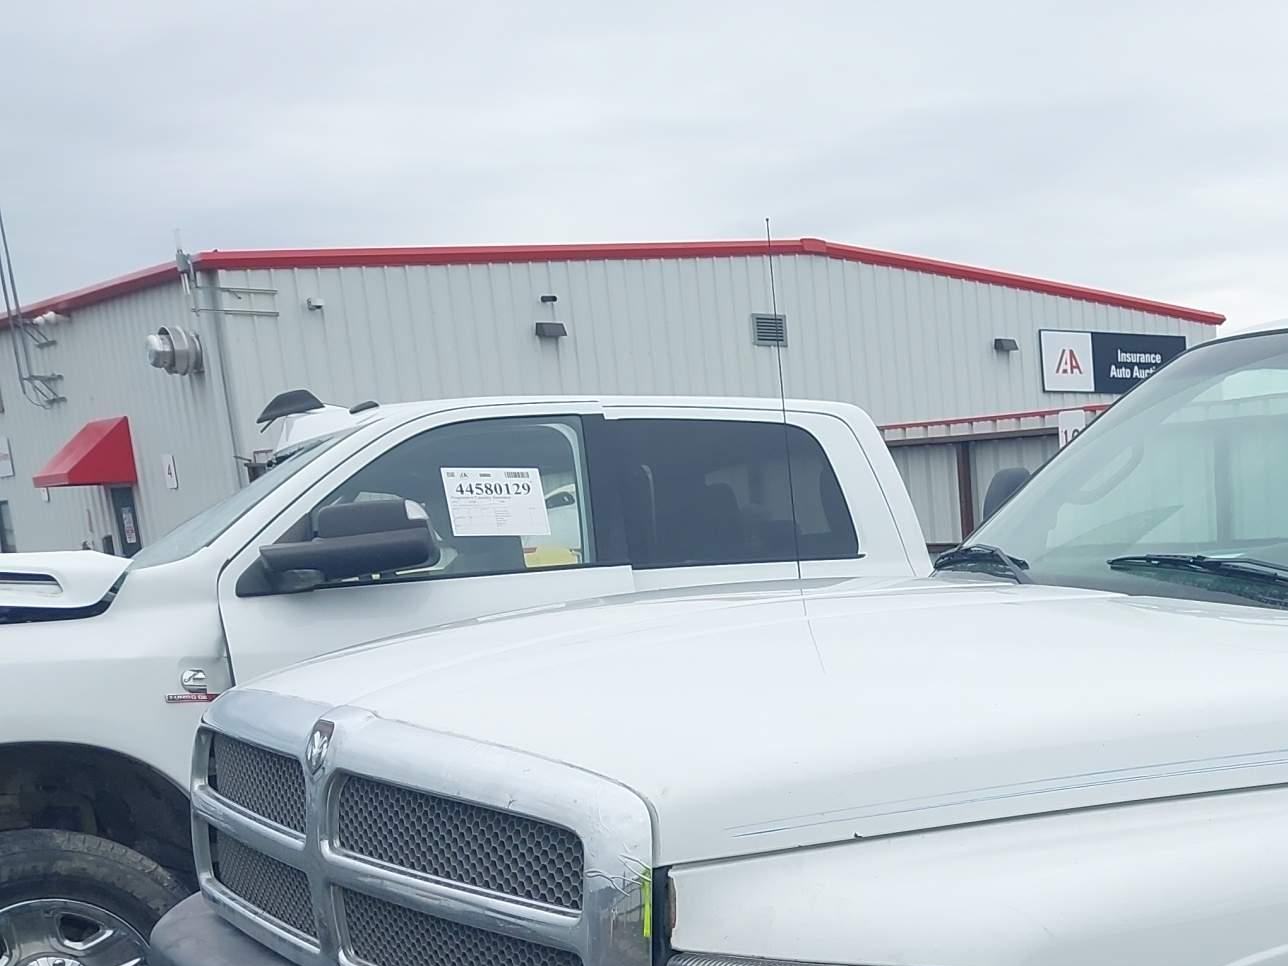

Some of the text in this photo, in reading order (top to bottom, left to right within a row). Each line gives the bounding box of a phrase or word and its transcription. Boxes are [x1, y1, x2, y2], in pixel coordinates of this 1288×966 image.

[1117, 349, 1161, 363] Insurance
[1110, 365, 1131, 378] Auto
[456, 483, 532, 495] 44580129
